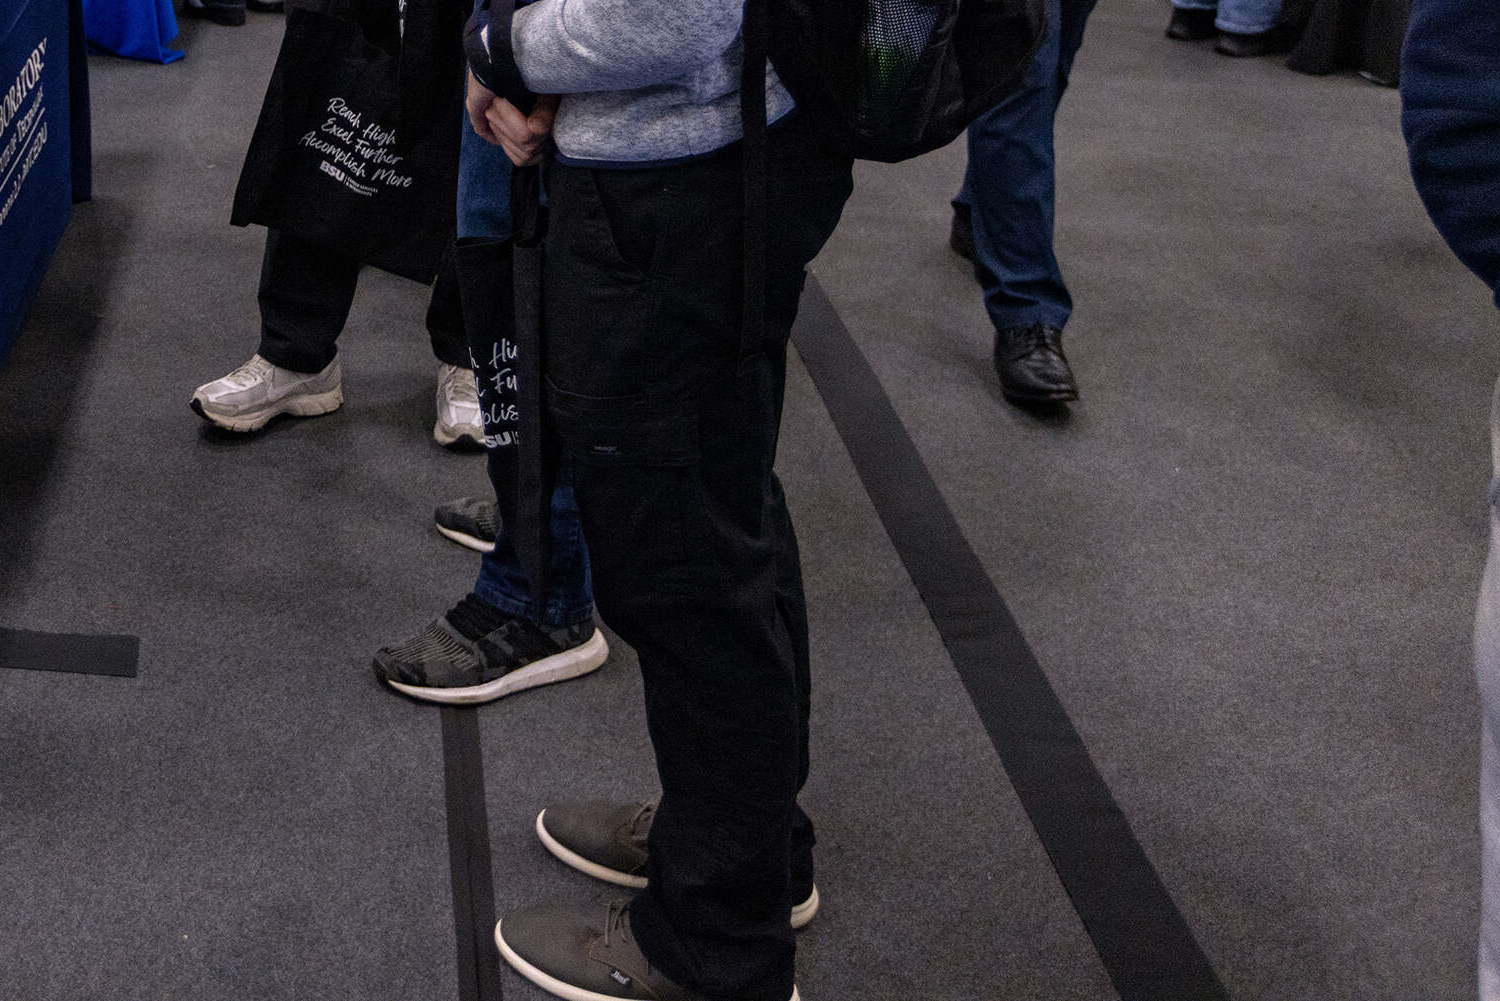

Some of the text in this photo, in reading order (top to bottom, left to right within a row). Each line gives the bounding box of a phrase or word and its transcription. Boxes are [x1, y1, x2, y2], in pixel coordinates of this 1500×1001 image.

[321, 117, 403, 165] Excel Further
[327, 97, 396, 146] Reach High
[298, 130, 413, 188] Accomplish More
[319, 160, 346, 182] BSU
[484, 432, 512, 448] SU
